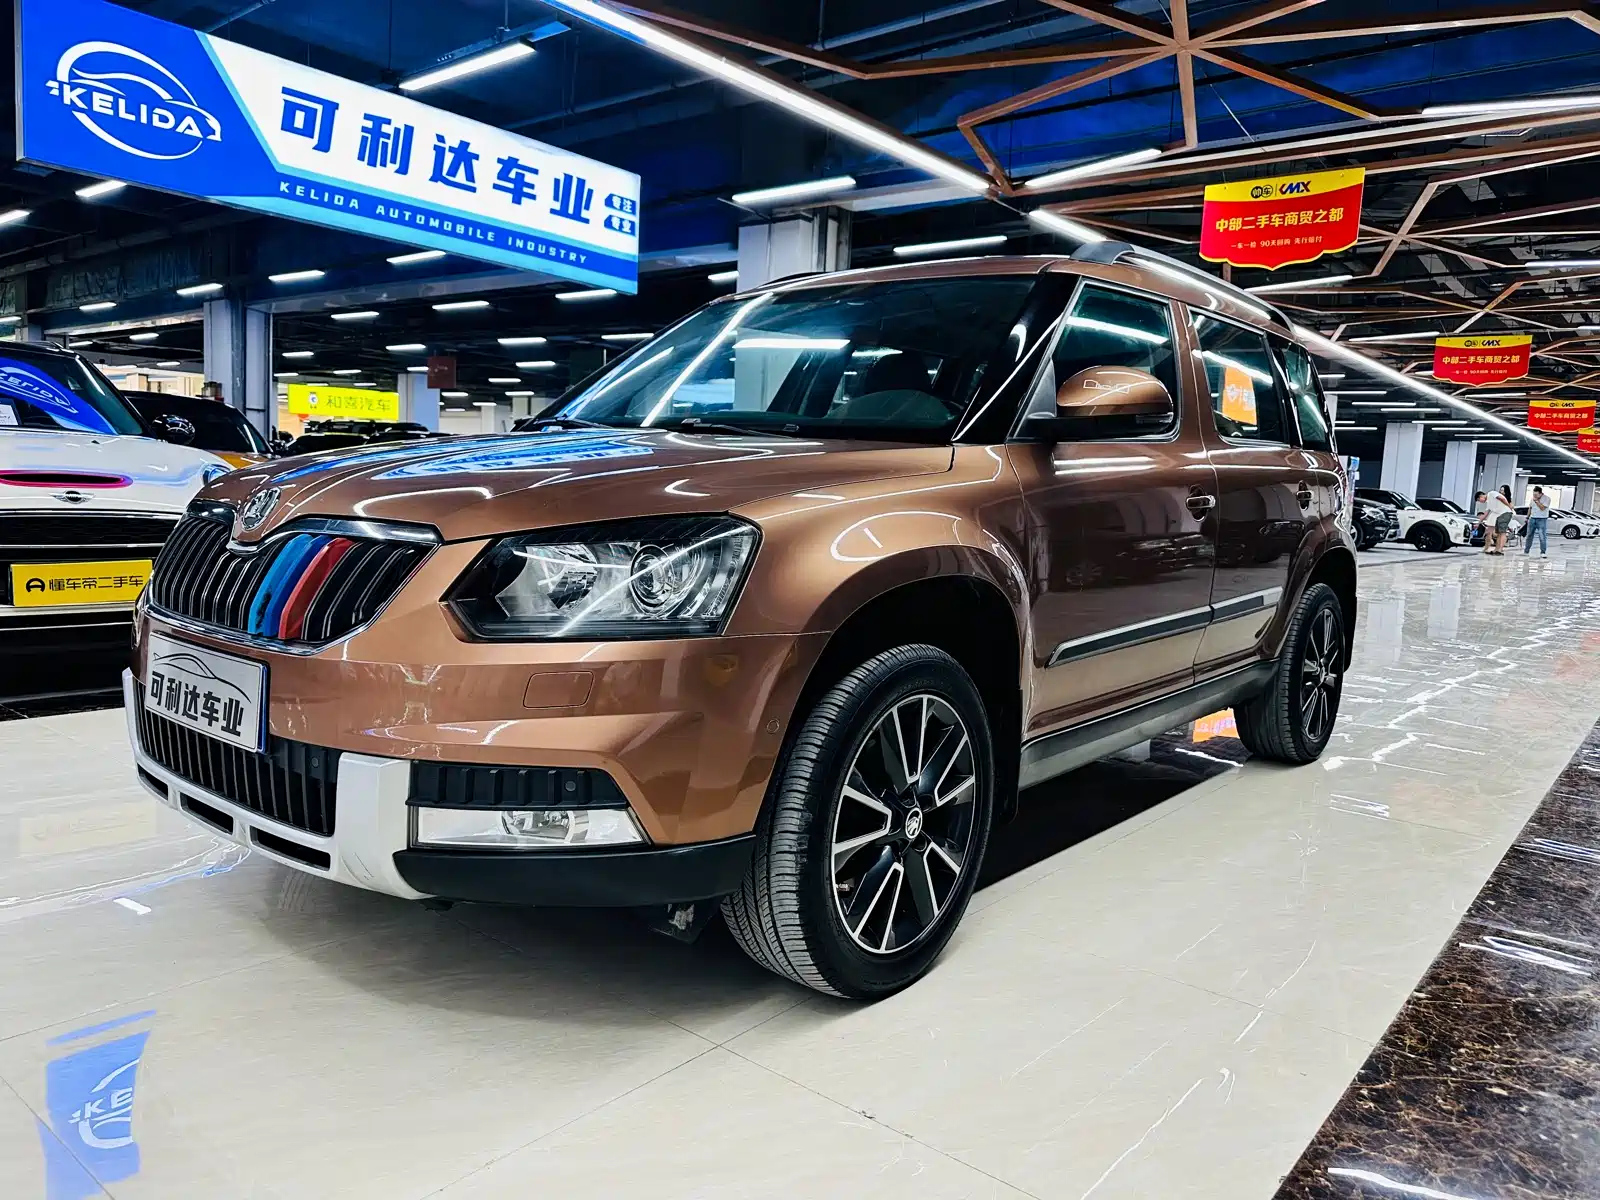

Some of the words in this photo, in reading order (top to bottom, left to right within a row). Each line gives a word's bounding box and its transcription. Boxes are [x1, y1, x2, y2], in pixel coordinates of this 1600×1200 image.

[63, 84, 203, 138] KELIDA
[281, 86, 593, 224] 可利达车业
[280, 181, 359, 210] KELIDA
[376, 204, 495, 242] AUTOMOBILE
[508, 236, 588, 264] INDUSTRY
[1215, 207, 1344, 232] 中部二手车商贸之都
[1442, 355, 1520, 365] 中部二手车商贸之都
[49, 575, 143, 591] 懂车帝二手车
[150, 670, 244, 737] 可利达车业
